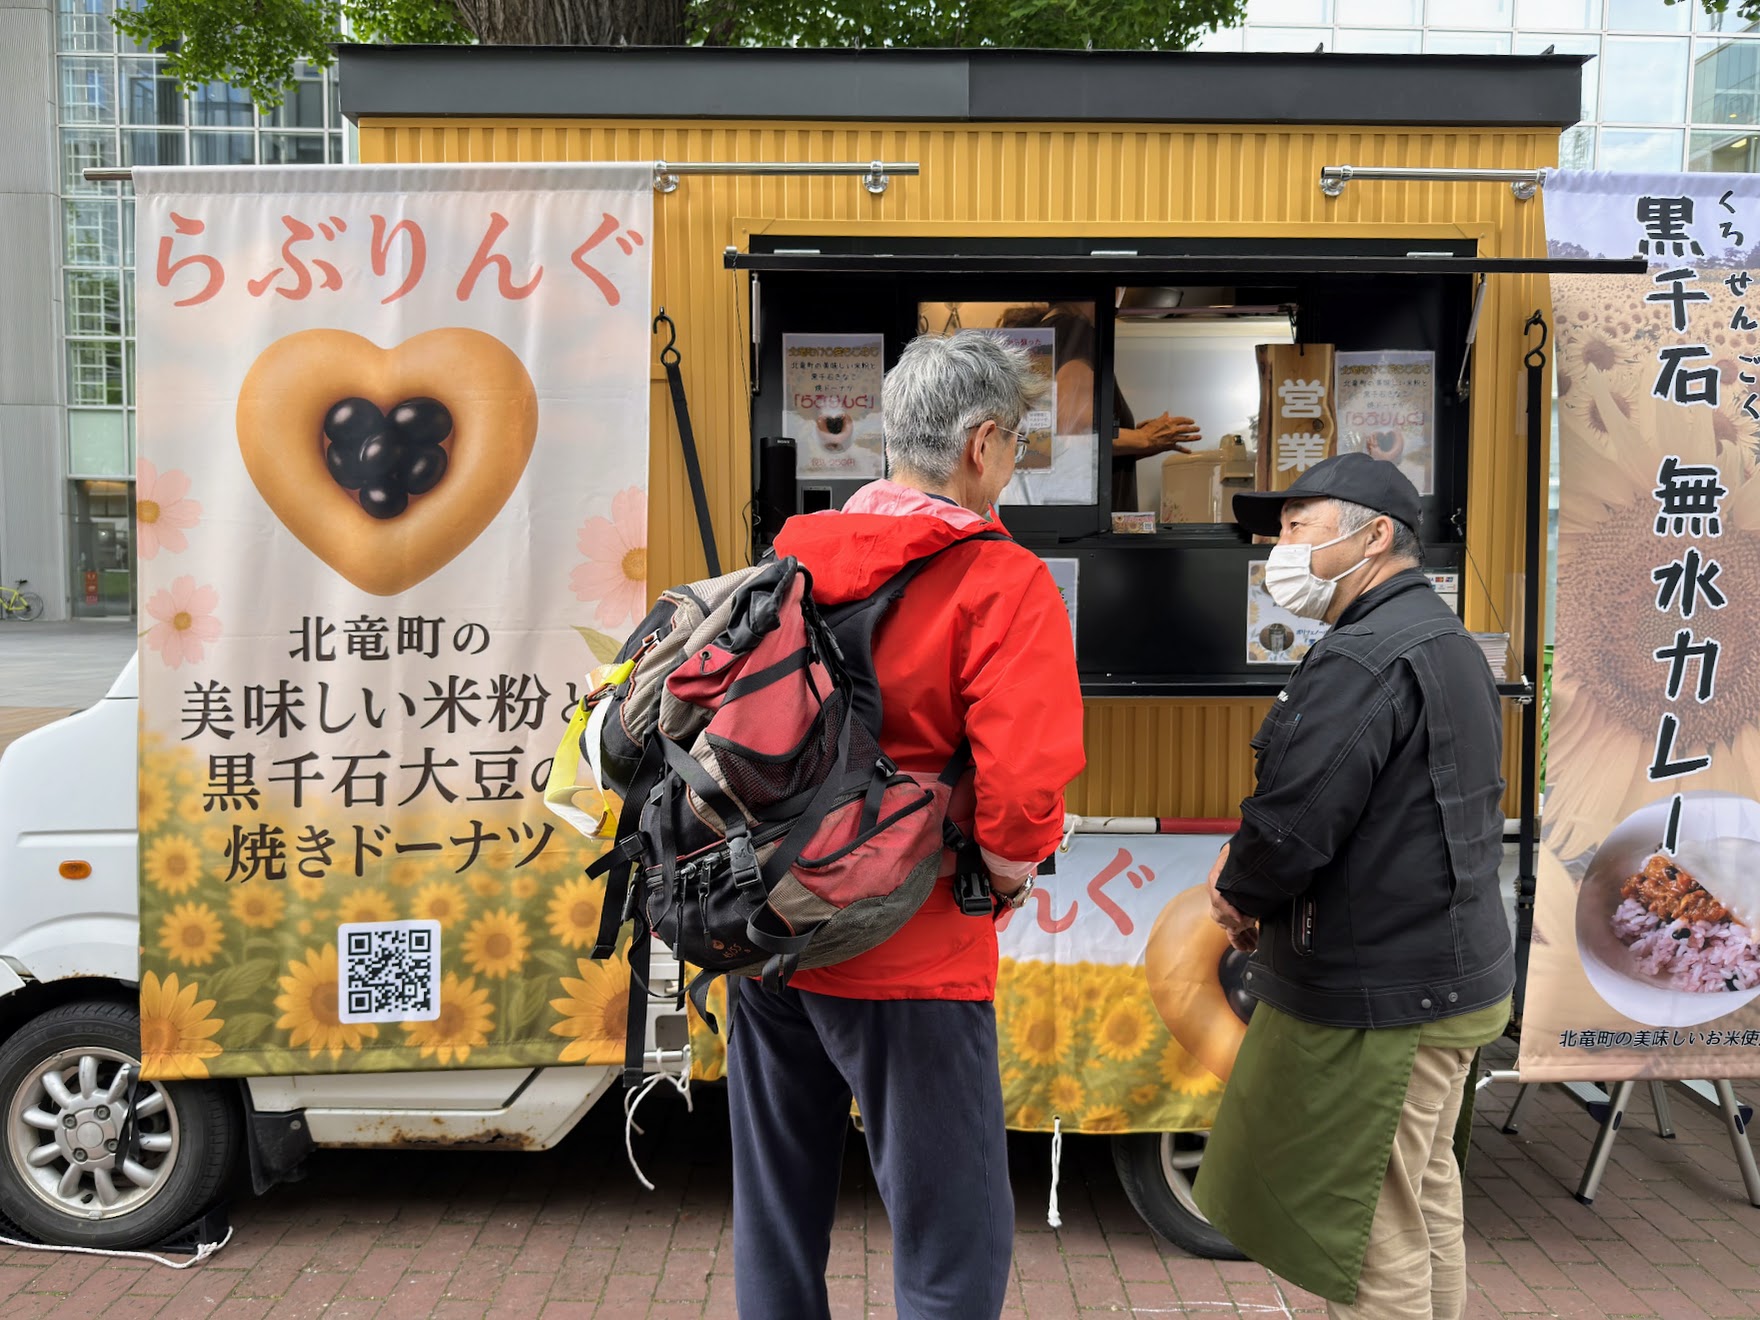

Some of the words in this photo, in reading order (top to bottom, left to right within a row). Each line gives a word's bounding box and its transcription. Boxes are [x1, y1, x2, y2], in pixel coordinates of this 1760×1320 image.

[156, 211, 645, 307] らぶりんぐ
[1637, 195, 1720, 406] 黒千石
[1277, 379, 1326, 472] 営業
[288, 614, 491, 662] 北竜町の
[1647, 456, 1727, 856] 無水カレー
[181, 673, 580, 741] 美味しい米粉と
[224, 819, 555, 884] 焼きドーナツ
[1559, 1029, 1760, 1048] 北竜町の美味しいお米使
